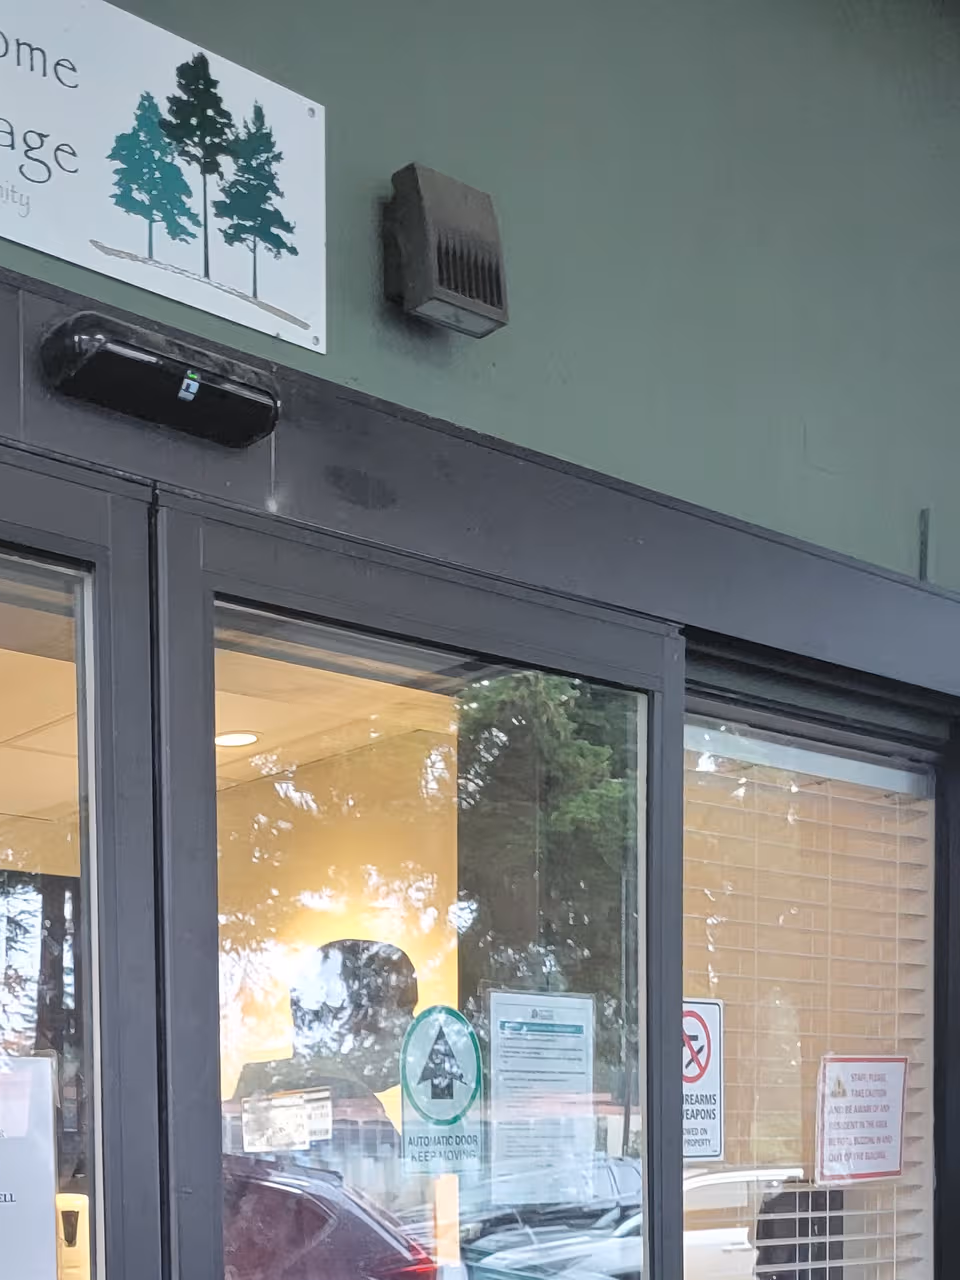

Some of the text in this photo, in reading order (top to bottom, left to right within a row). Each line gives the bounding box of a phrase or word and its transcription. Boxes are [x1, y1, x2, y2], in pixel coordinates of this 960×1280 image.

[408, 1135, 478, 1147] AUTOMATIC DOOR
[411, 1149, 477, 1162] KEEP MOVING
